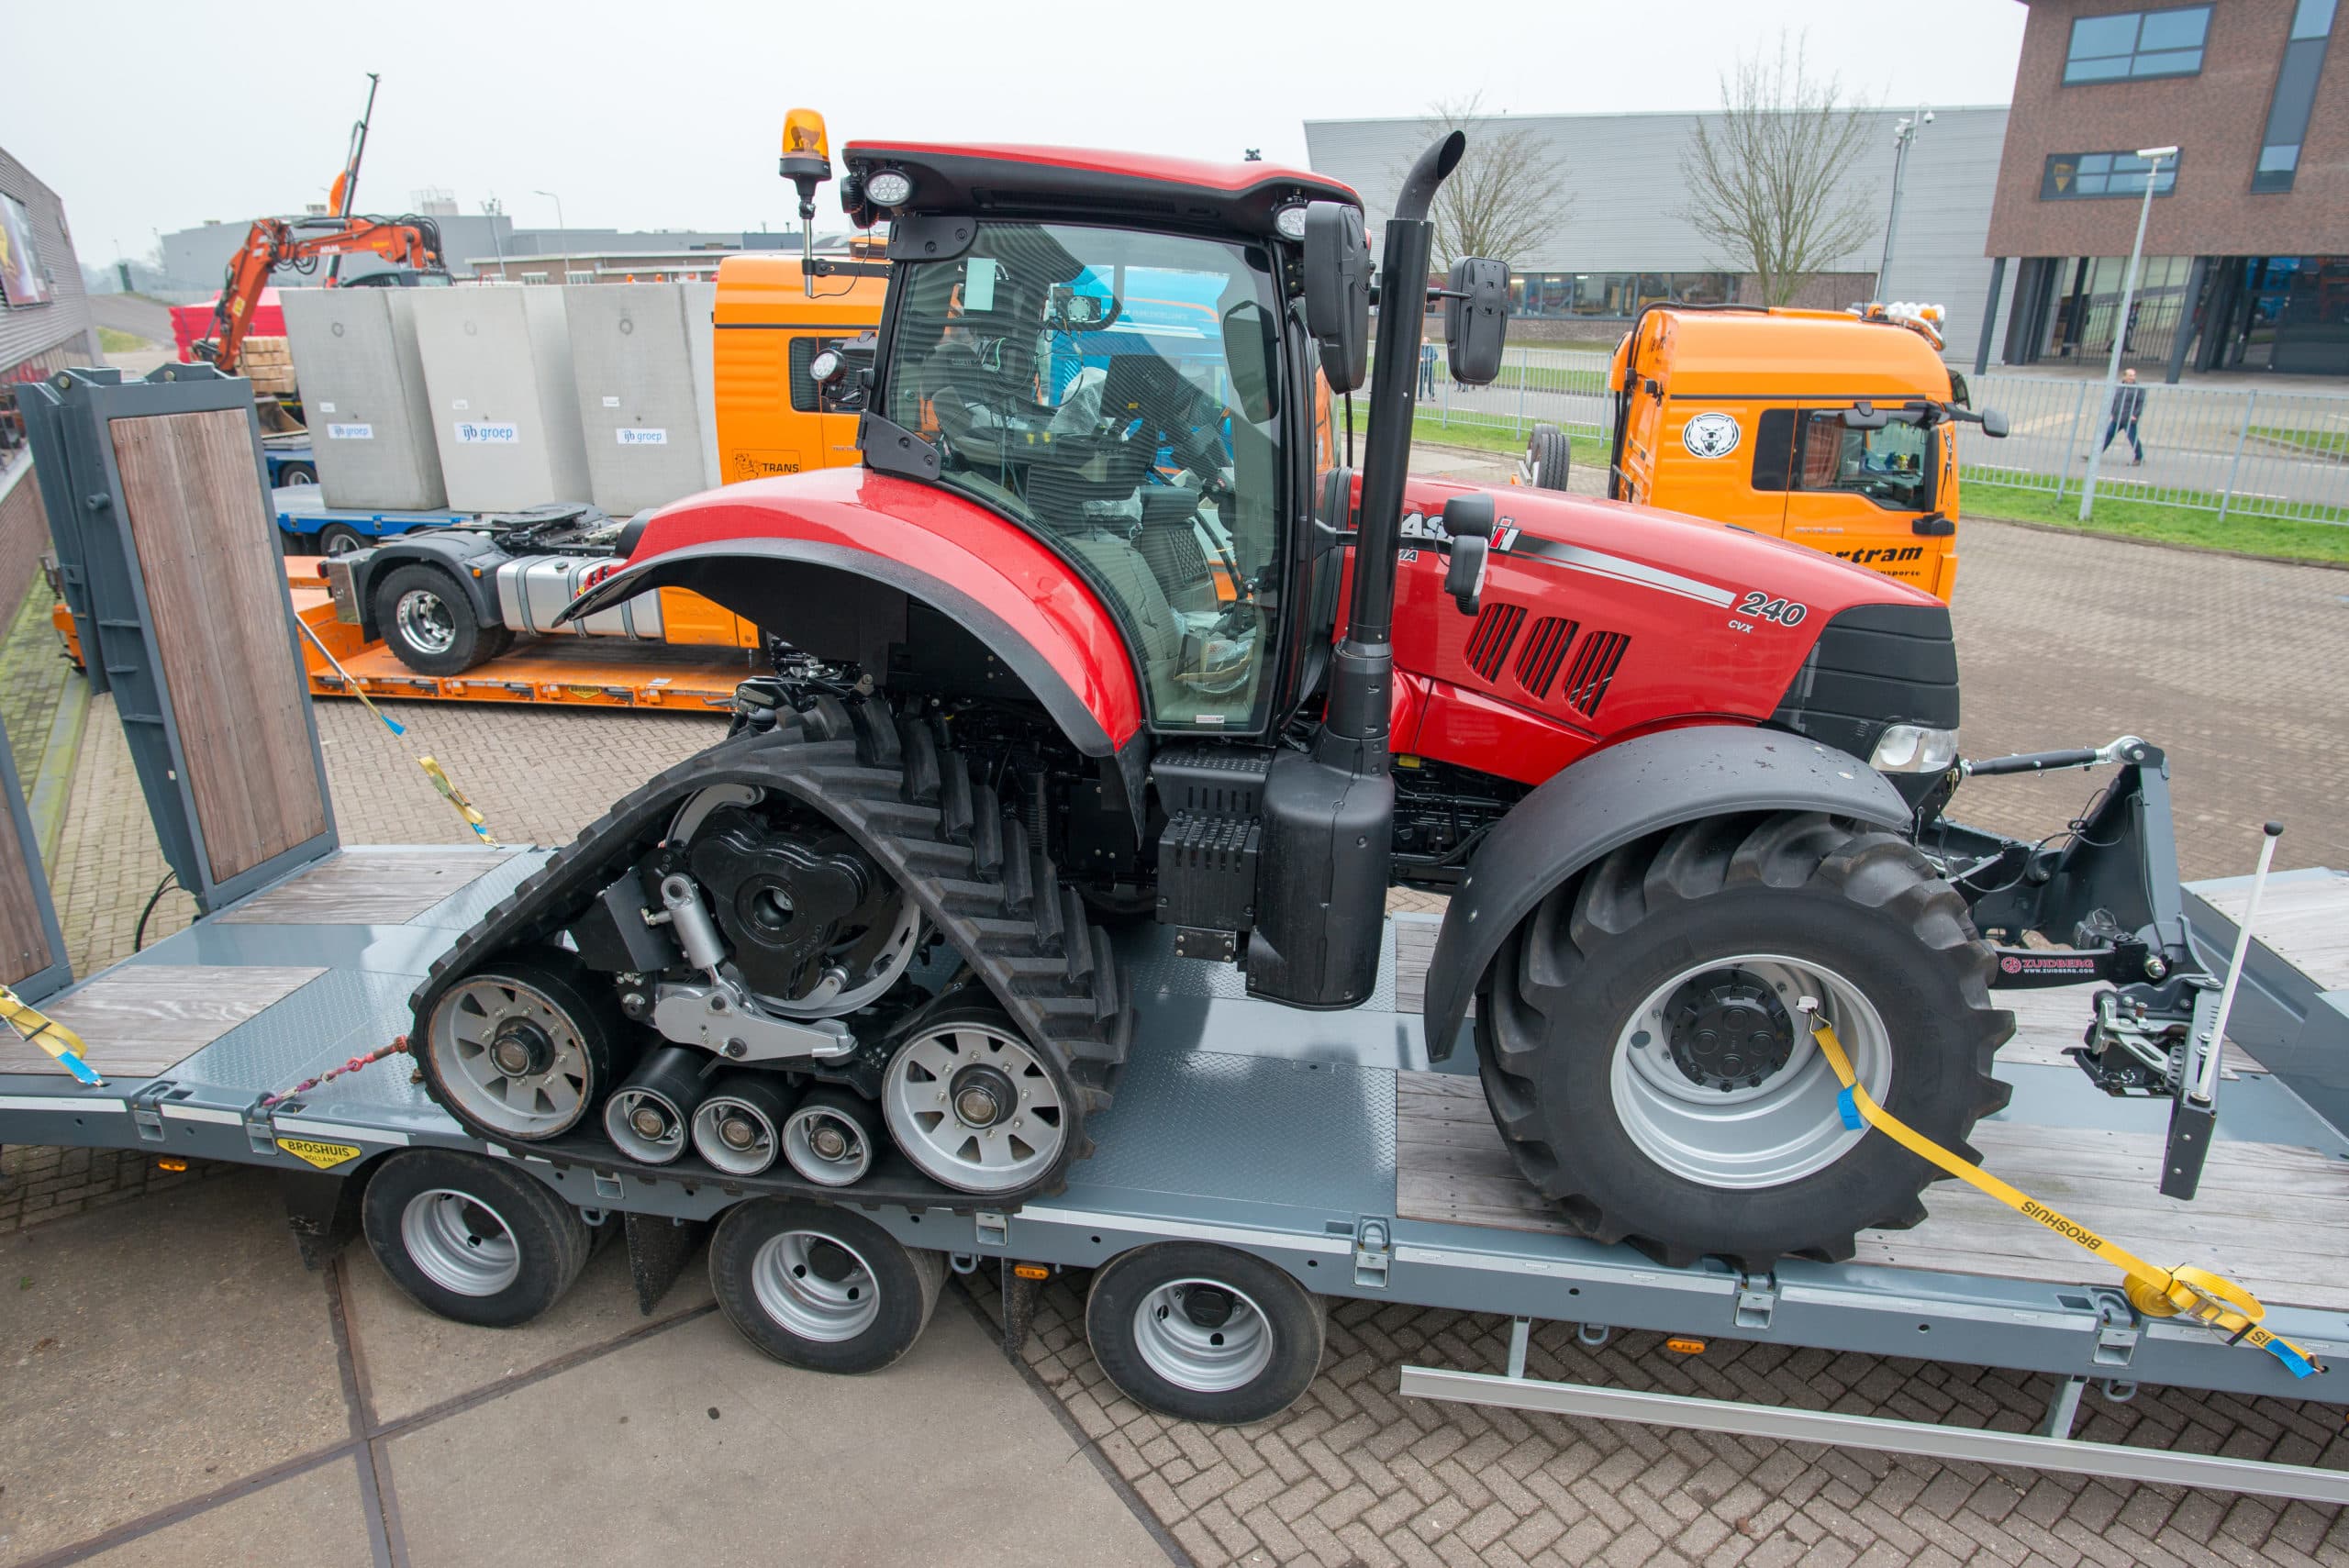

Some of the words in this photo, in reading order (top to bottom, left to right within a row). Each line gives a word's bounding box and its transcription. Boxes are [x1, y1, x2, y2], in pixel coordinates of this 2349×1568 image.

[346, 426, 369, 438] groep
[481, 428, 513, 440] groep
[637, 432, 662, 442] groep
[763, 462, 799, 473] TRANS
[1736, 591, 1807, 627] 240
[1728, 620, 1753, 633] CVX
[2022, 959, 2094, 968] ZUIDBERG
[287, 1140, 351, 1157] BROSHUIS
[304, 1154, 339, 1164] HOLLAND
[2021, 1201, 2102, 1250] BROSHUIS
